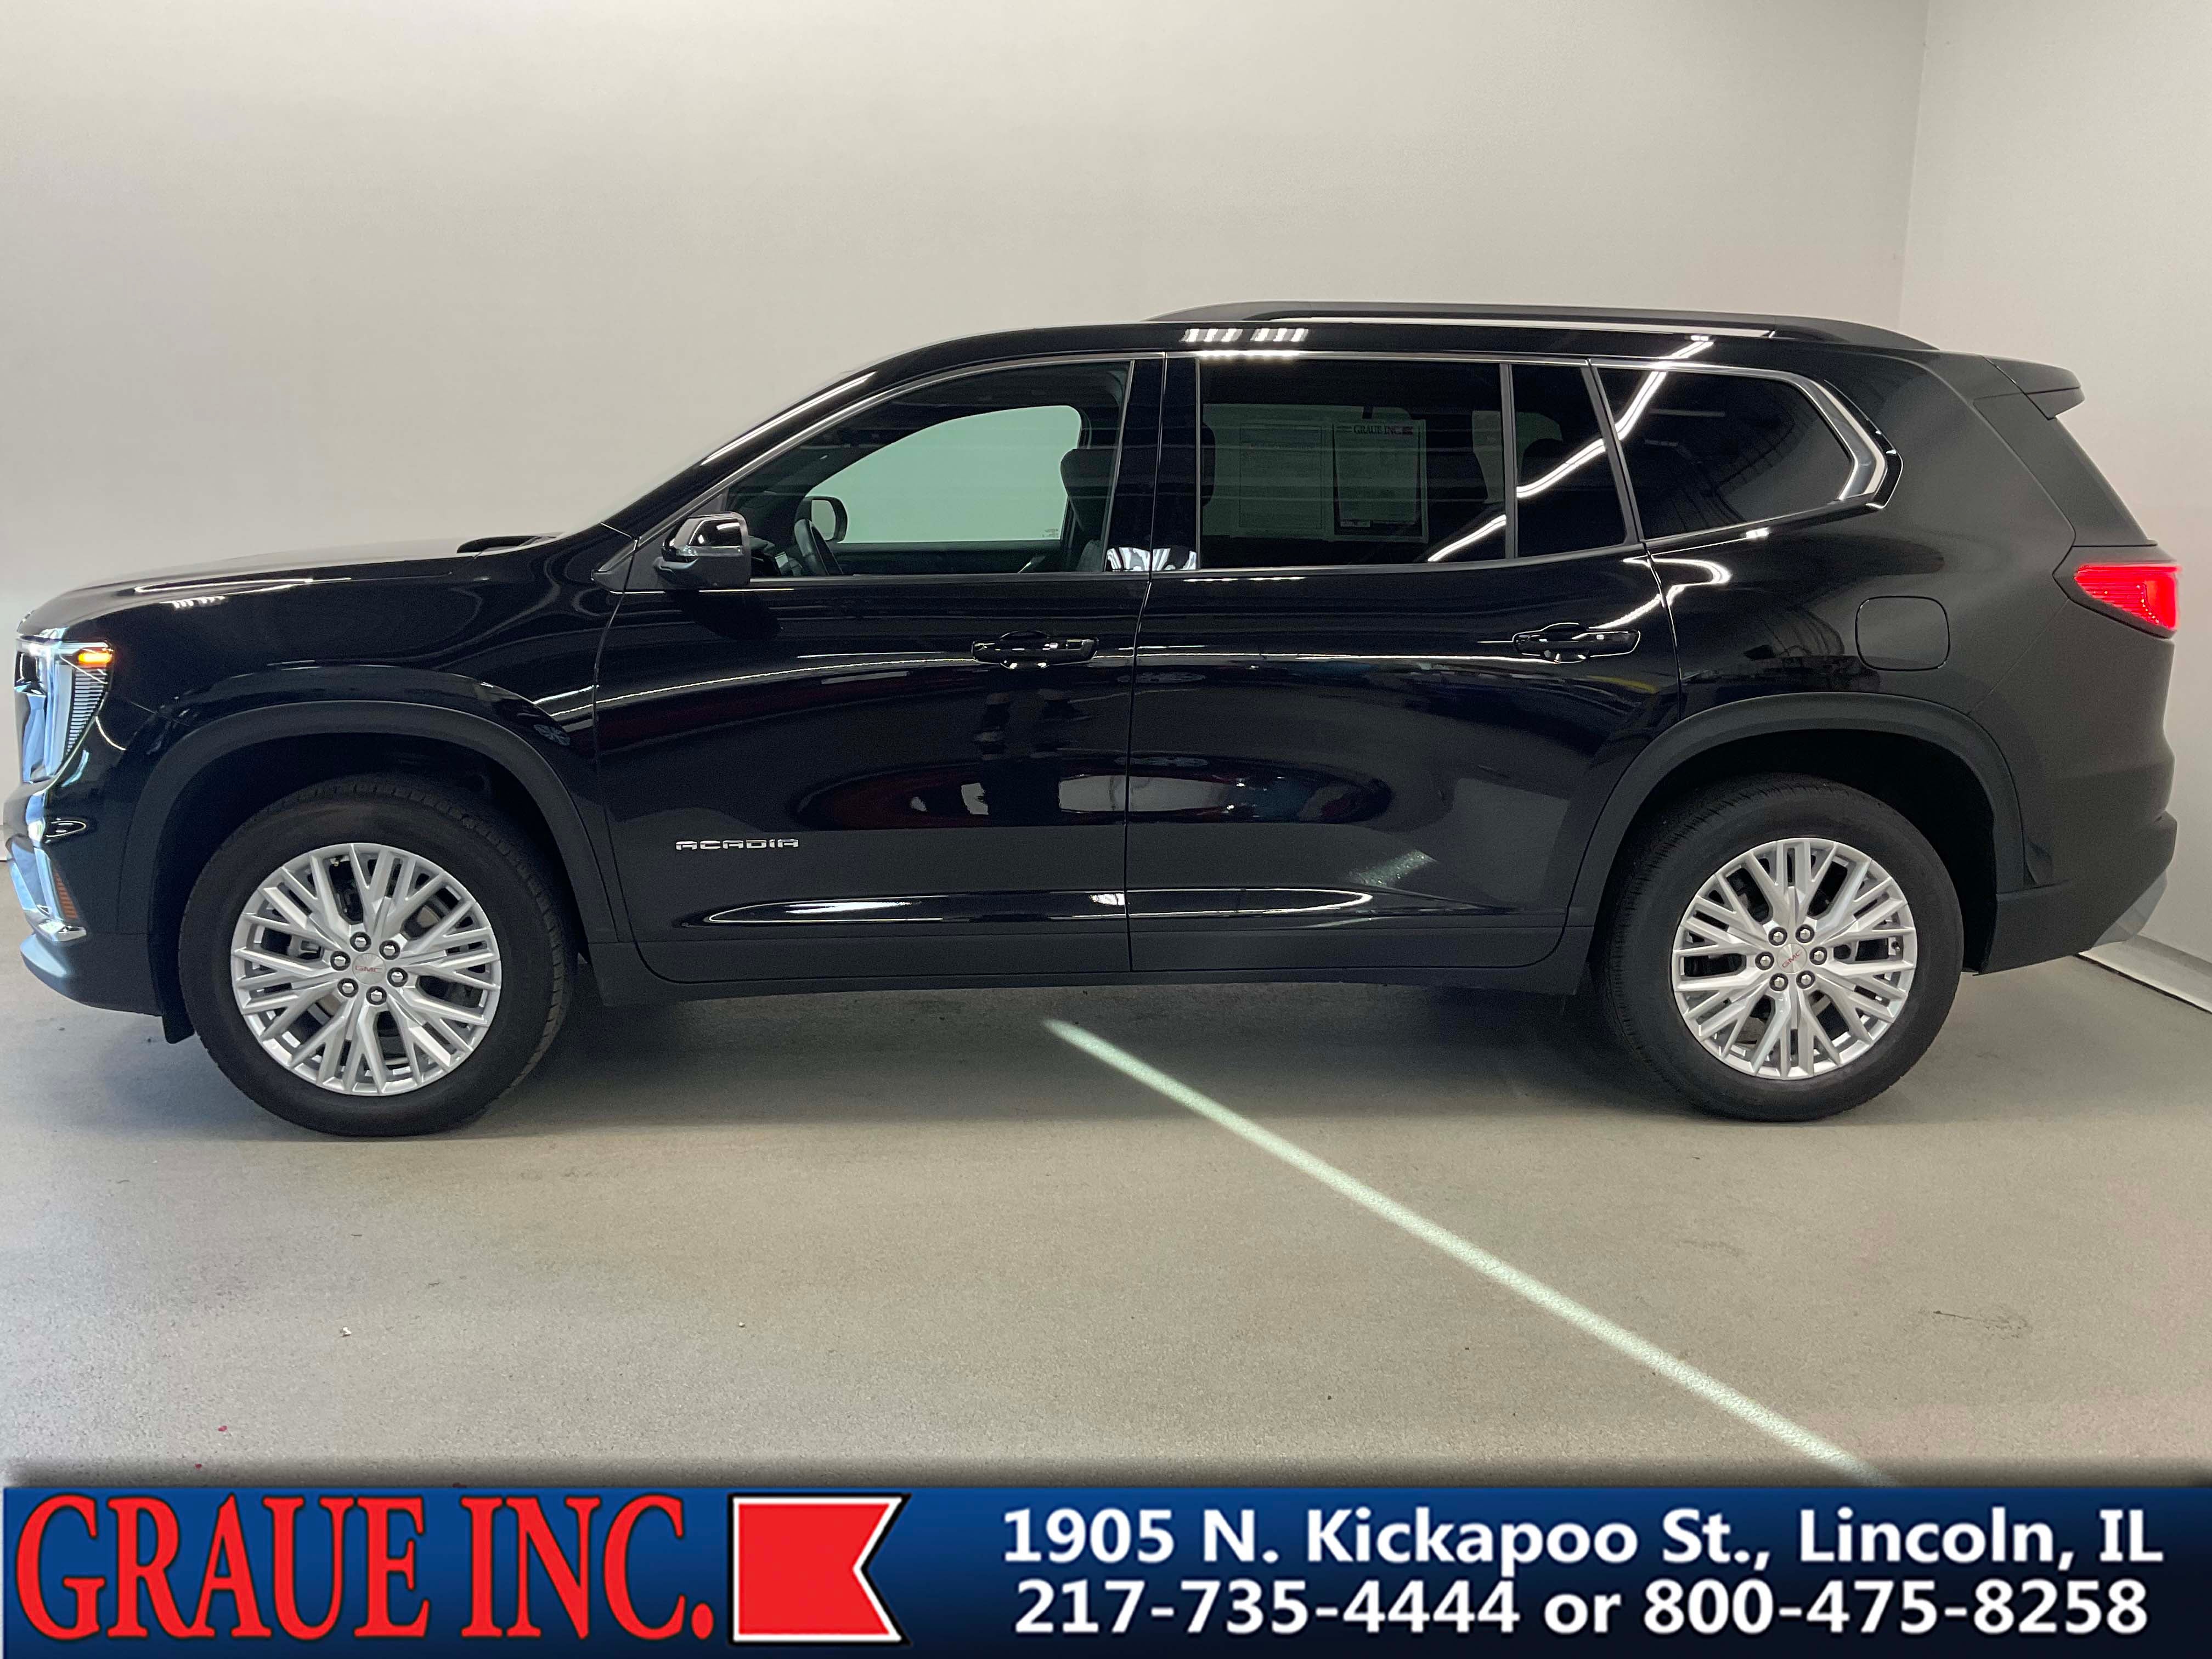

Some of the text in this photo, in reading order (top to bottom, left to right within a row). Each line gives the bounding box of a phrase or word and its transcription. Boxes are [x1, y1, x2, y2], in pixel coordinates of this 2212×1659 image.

[675, 838, 799, 850] ACADIA
[1781, 949, 1803, 968] GMC
[355, 965, 382, 973] GMC
